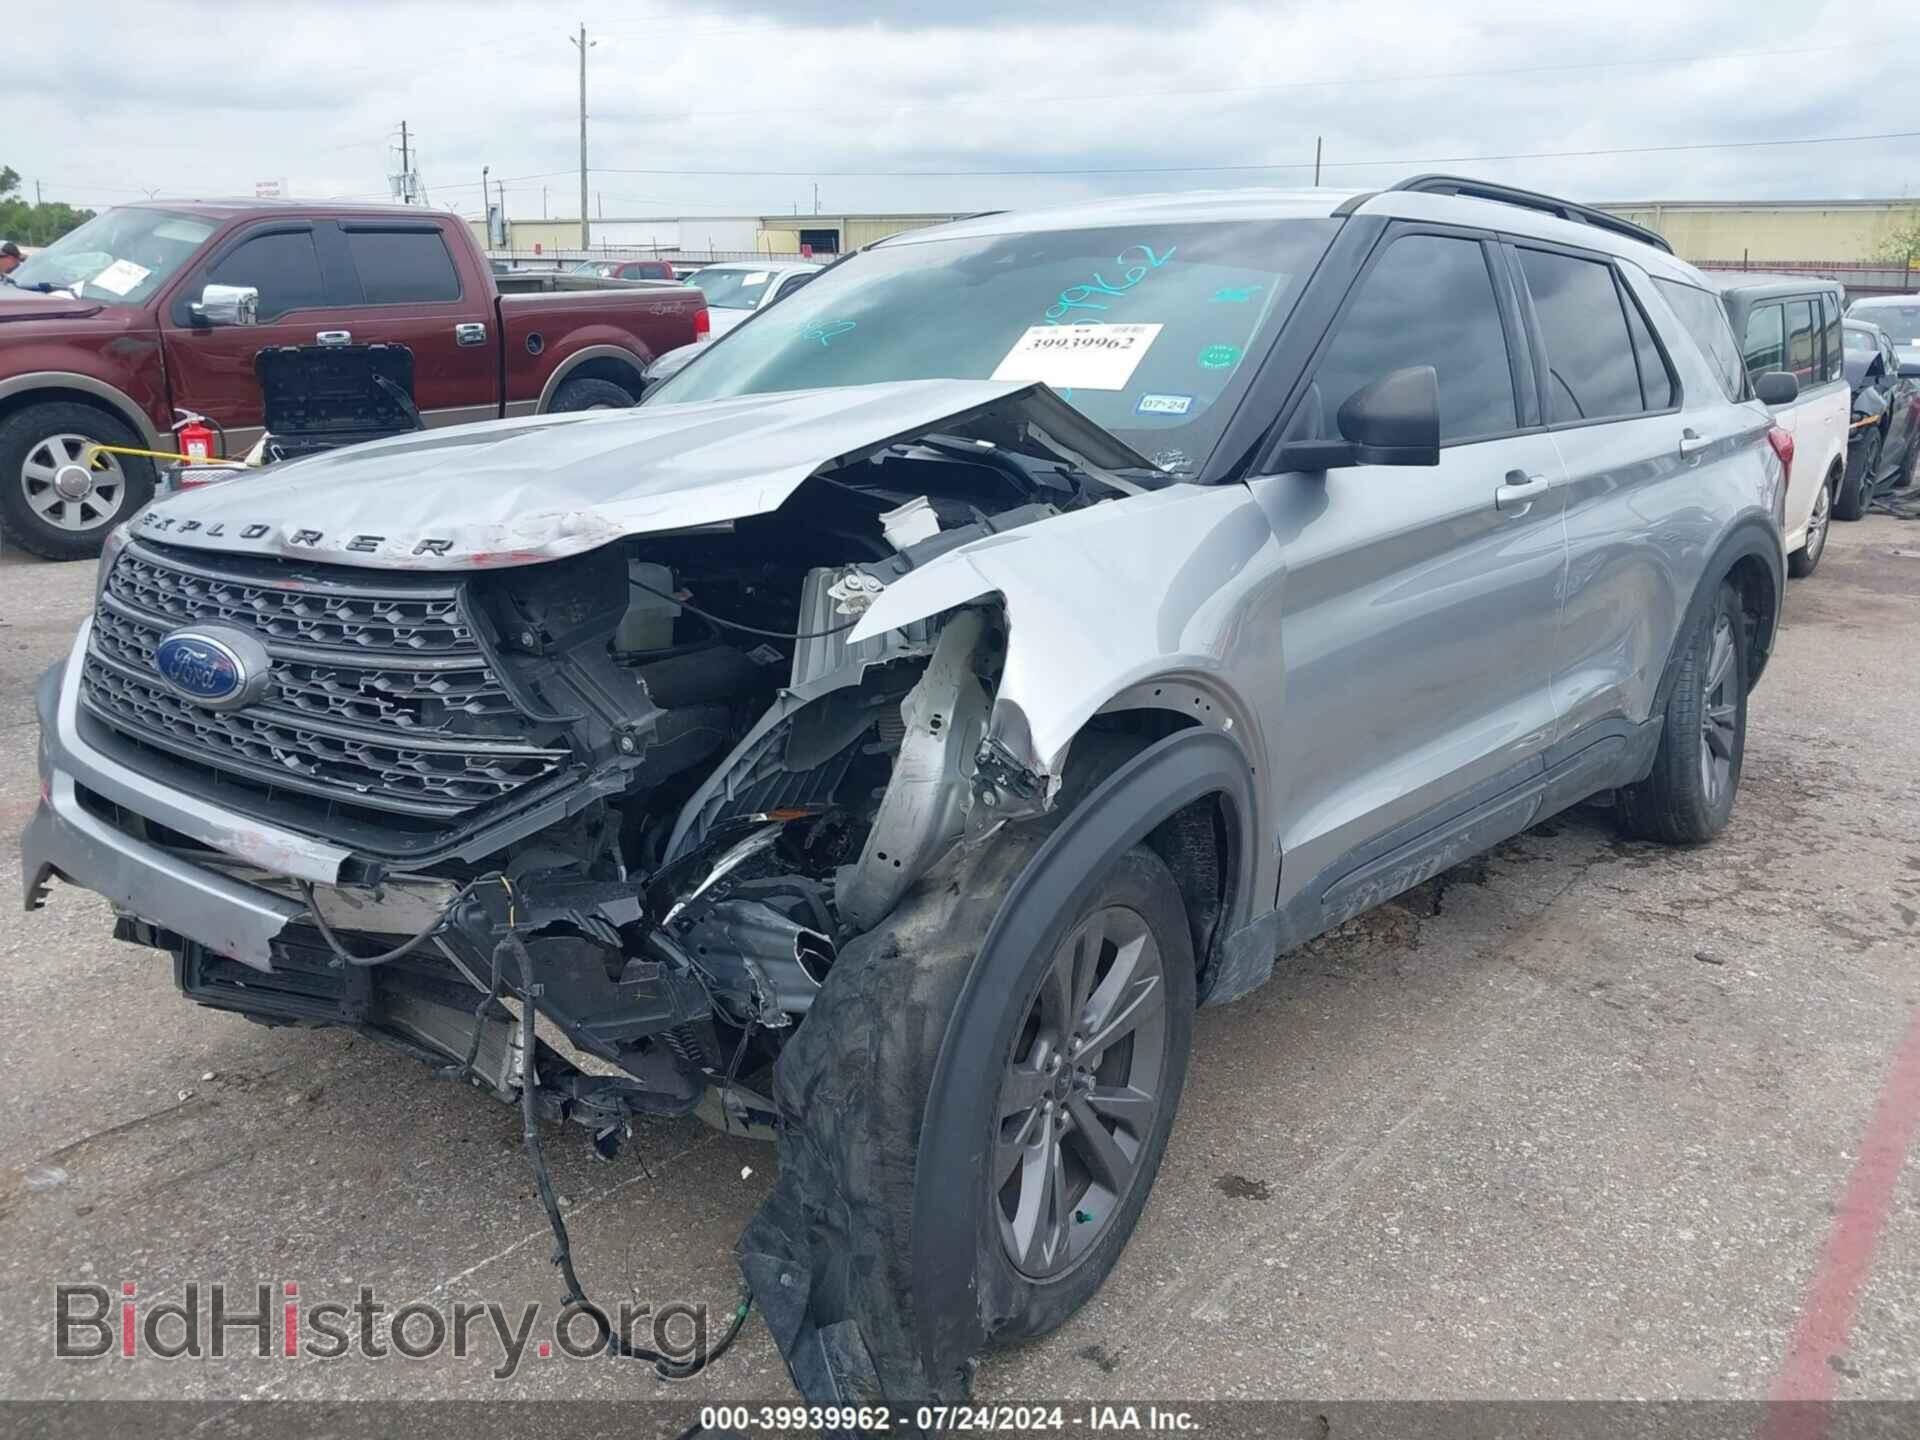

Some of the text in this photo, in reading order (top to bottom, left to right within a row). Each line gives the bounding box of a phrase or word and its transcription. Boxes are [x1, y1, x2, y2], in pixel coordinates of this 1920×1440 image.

[1026, 336, 1135, 351] 39939962
[139, 510, 455, 558] EXPLORER
[169, 646, 217, 689] Ford
